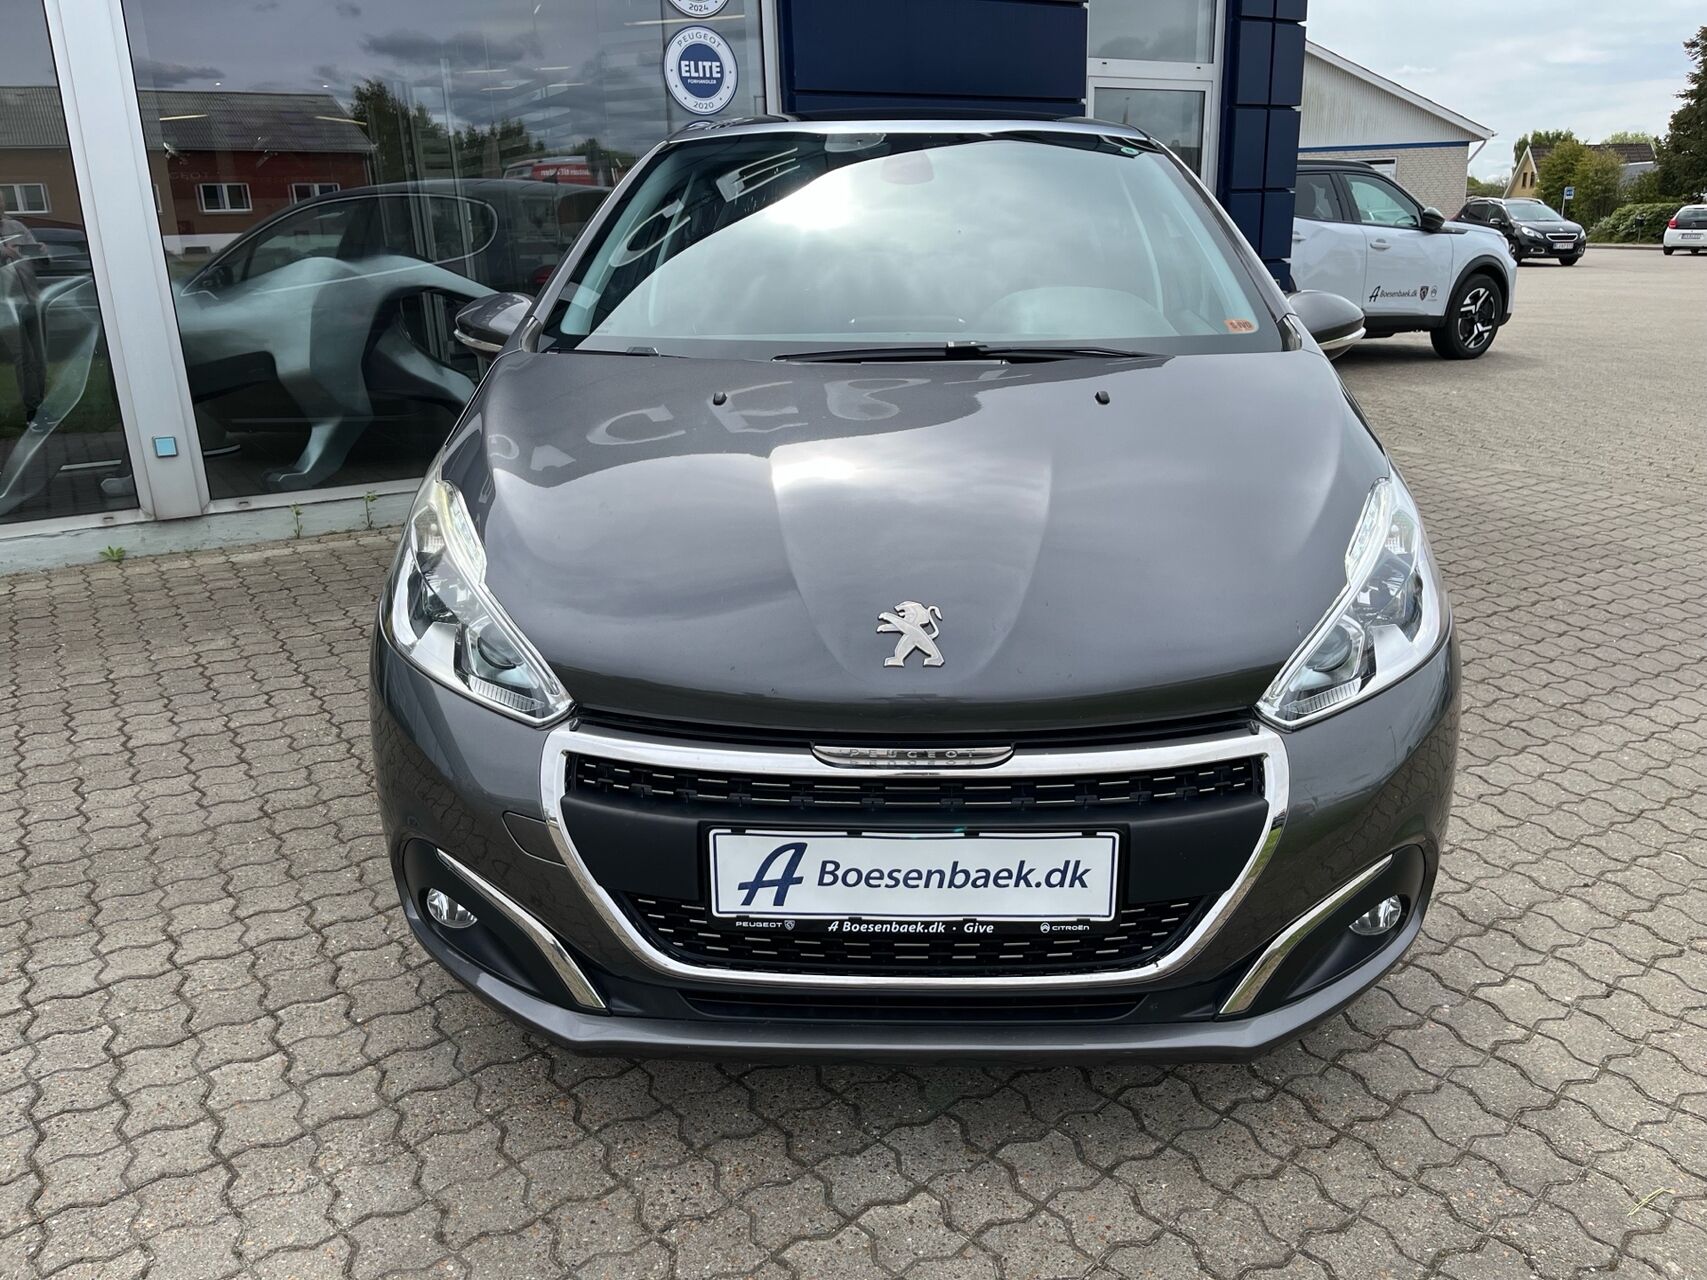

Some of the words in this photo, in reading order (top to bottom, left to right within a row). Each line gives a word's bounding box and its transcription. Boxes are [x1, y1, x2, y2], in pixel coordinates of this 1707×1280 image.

[688, 3, 709, 12] 2024
[677, 31, 722, 48] PEUGEOT
[680, 60, 721, 78] ELITE
[693, 101, 714, 110] 2020
[849, 749, 975, 758] PEUGEOT
[817, 859, 1092, 889] Boesenbaek.dk
[842, 921, 946, 934] Boesenbaek.dk
[964, 922, 994, 933] Give
